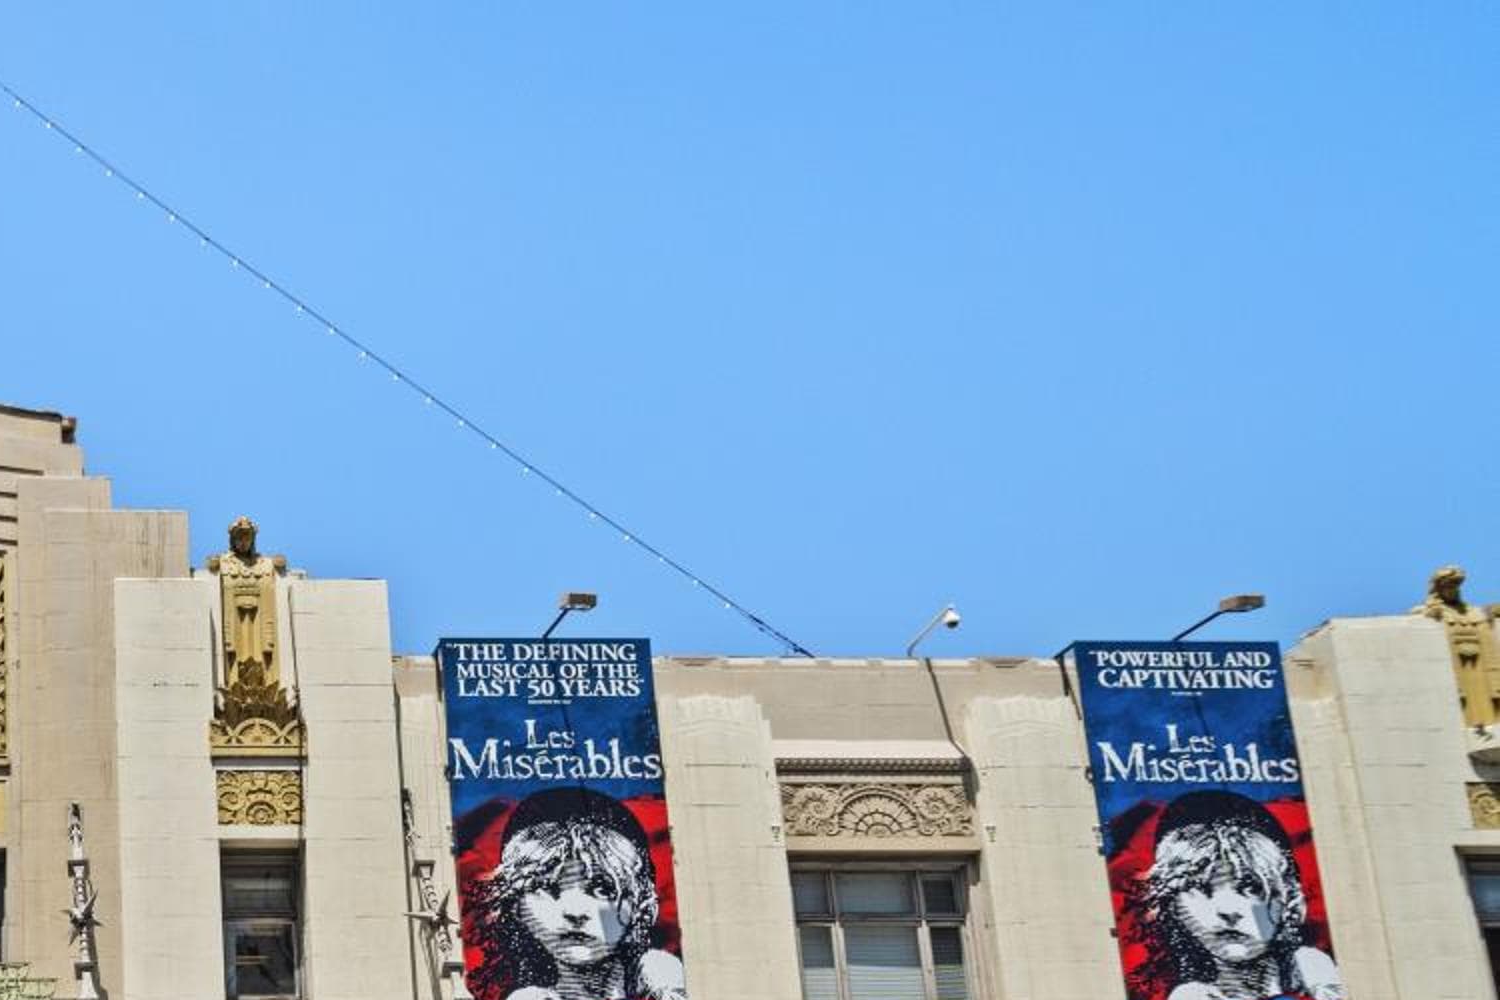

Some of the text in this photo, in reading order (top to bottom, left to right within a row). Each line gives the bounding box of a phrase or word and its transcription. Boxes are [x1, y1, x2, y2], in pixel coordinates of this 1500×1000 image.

[513, 643, 637, 661] DEFINING
[1224, 651, 1271, 668] AND
[456, 663, 639, 679] MUSICAL OF THE
[458, 679, 521, 697] LAST
[528, 680, 554, 698] 50
[524, 719, 576, 749] Les
[1166, 724, 1217, 753] Les
[449, 737, 663, 780] Misérables
[1097, 742, 1299, 783] Misérables
